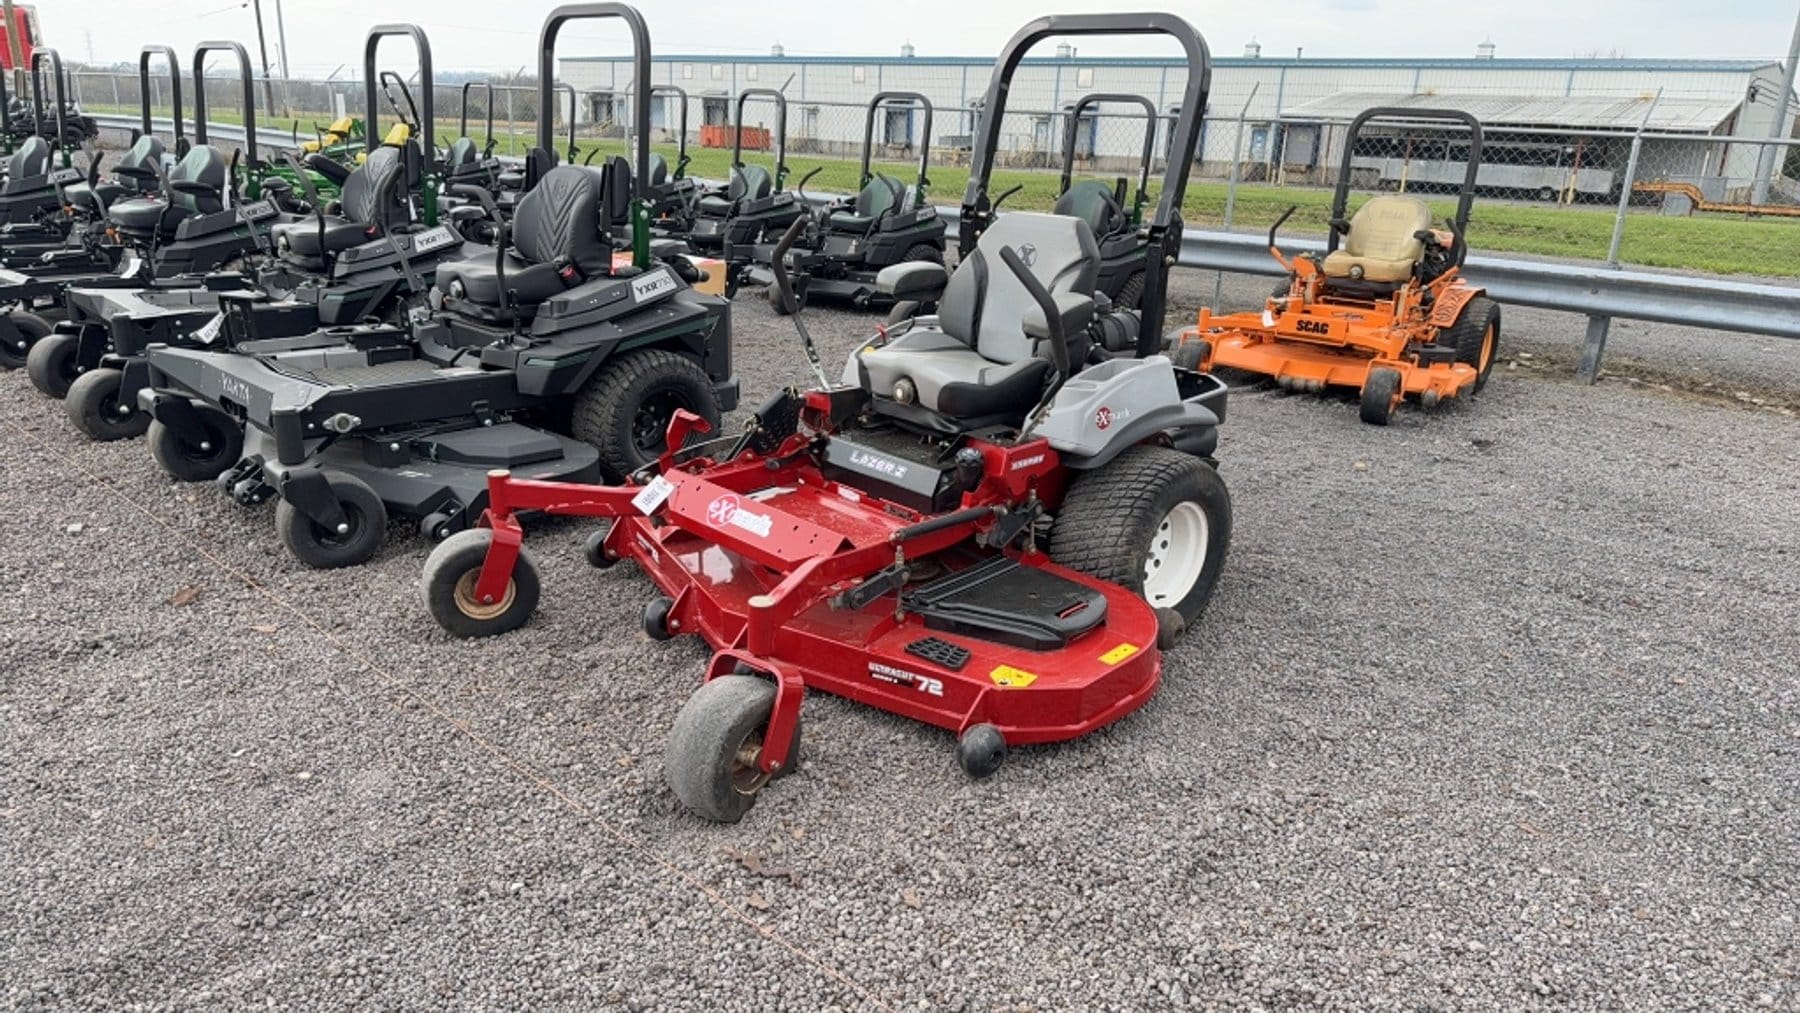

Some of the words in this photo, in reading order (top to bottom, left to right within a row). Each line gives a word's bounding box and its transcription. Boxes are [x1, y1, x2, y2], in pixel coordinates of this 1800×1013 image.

[1296, 320, 1329, 335] SCAG
[850, 450, 895, 476] LAZER
[915, 674, 944, 697] 72
